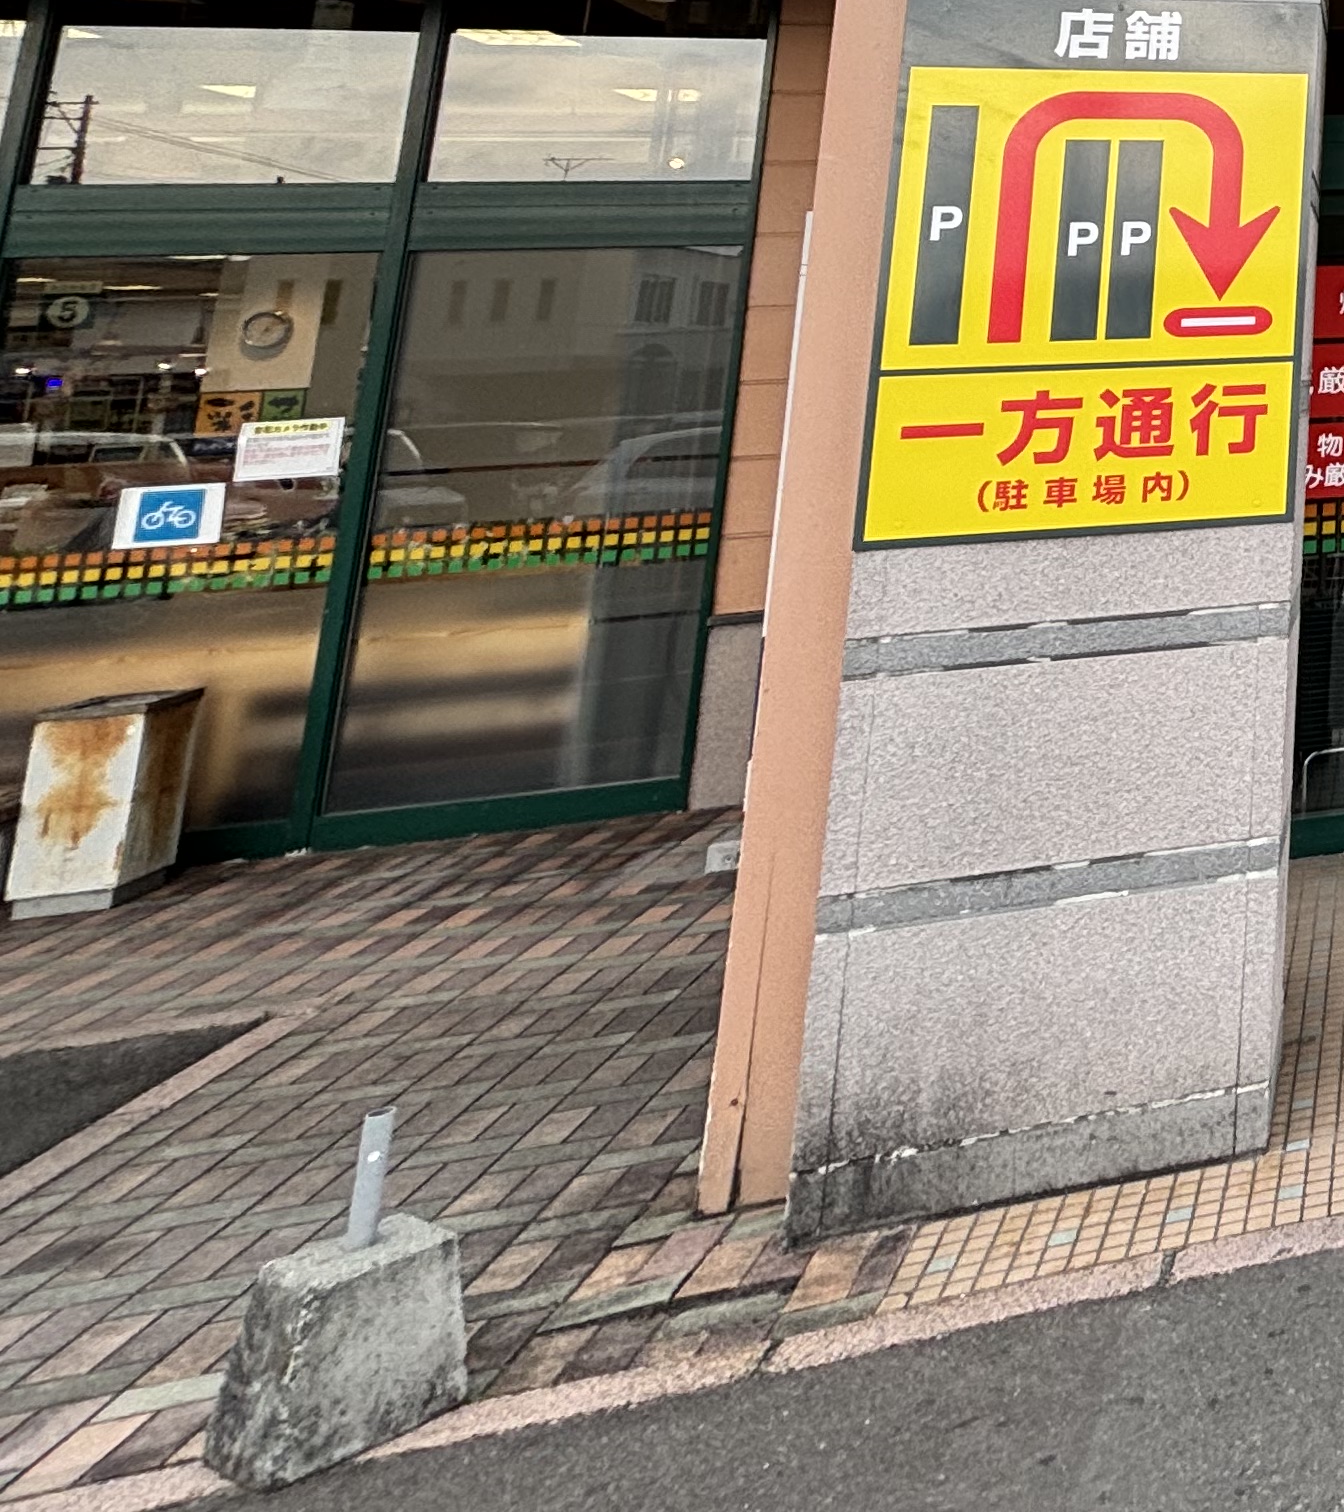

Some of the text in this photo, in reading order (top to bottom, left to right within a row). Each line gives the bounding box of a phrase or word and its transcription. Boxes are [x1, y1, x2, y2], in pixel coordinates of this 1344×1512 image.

[1054, 8, 1182, 61] 店舗
[930, 205, 963, 242] P
[1067, 220, 1152, 257] P P
[57, 299, 77, 322] 5
[900, 383, 1268, 467] 一方通行
